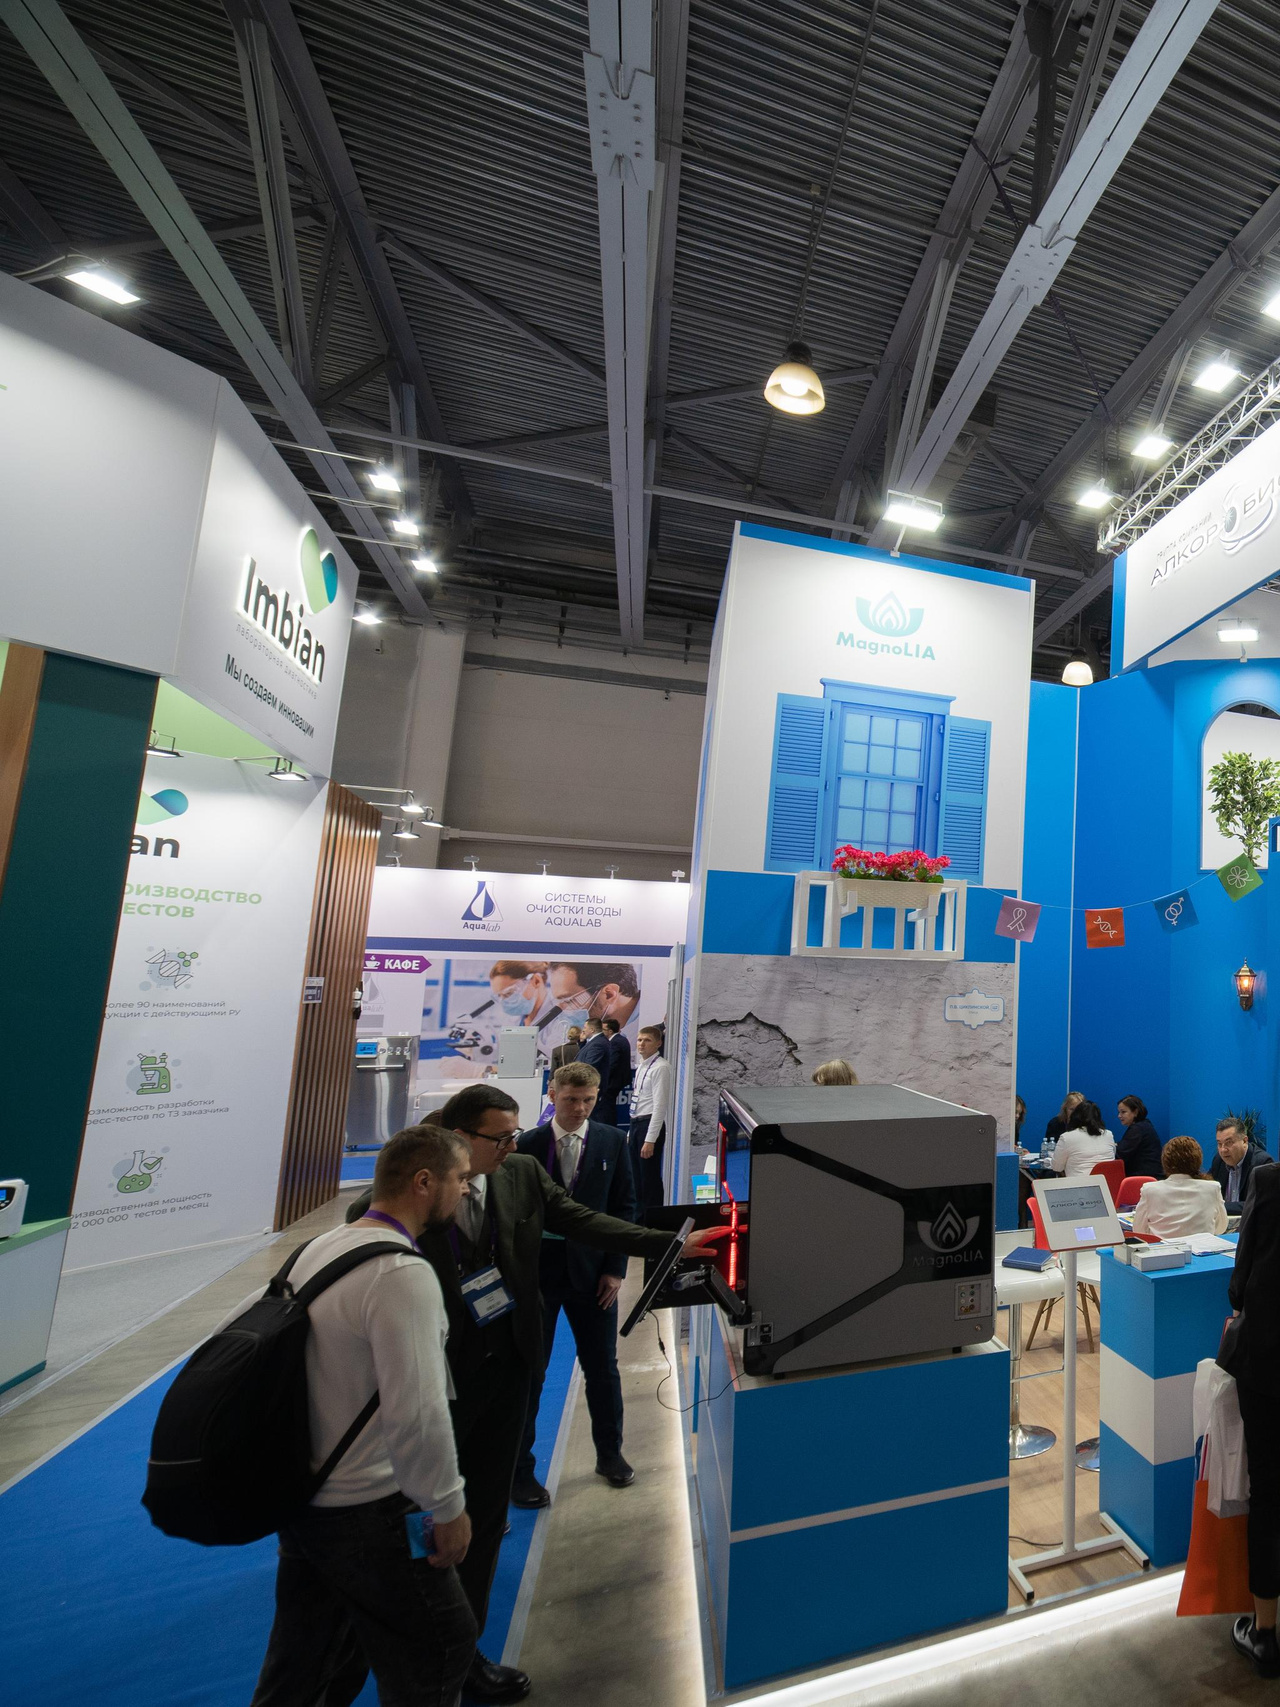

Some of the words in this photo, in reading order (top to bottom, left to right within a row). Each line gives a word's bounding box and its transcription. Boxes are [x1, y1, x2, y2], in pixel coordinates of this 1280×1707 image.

[1151, 524, 1218, 586] АЛКОР
[243, 556, 326, 683] Imbian
[836, 631, 936, 661] MagnoLIA
[225, 653, 242, 682] Мы
[243, 672, 278, 711] создаем
[278, 700, 315, 739] инновации
[544, 892, 606, 904] СИСТЕМЫ
[526, 903, 584, 915] ОЧИСТКИ
[587, 906, 622, 917] ВОДЫ
[462, 921, 501, 933] Aqualab
[544, 916, 602, 928] AQUALAB
[384, 959, 420, 970] КАФЕ
[106, 1001, 134, 1009] олее
[136, 1001, 151, 1009] 90
[152, 1000, 226, 1009] наименований
[105, 1011, 141, 1020] укции
[150, 1009, 227, 1018] действующими
[157, 1099, 215, 1110] разработки
[152, 1112, 165, 1120] по
[168, 1110, 180, 1118] ТЗ
[181, 1106, 230, 1117] заказчика
[161, 1193, 213, 1205] мощность
[82, 1217, 105, 1228] 000
[106, 1213, 129, 1224] 000
[134, 1208, 168, 1219] тестов
[178, 1201, 209, 1212] месяц
[913, 1248, 984, 1268] MagnoLIA
